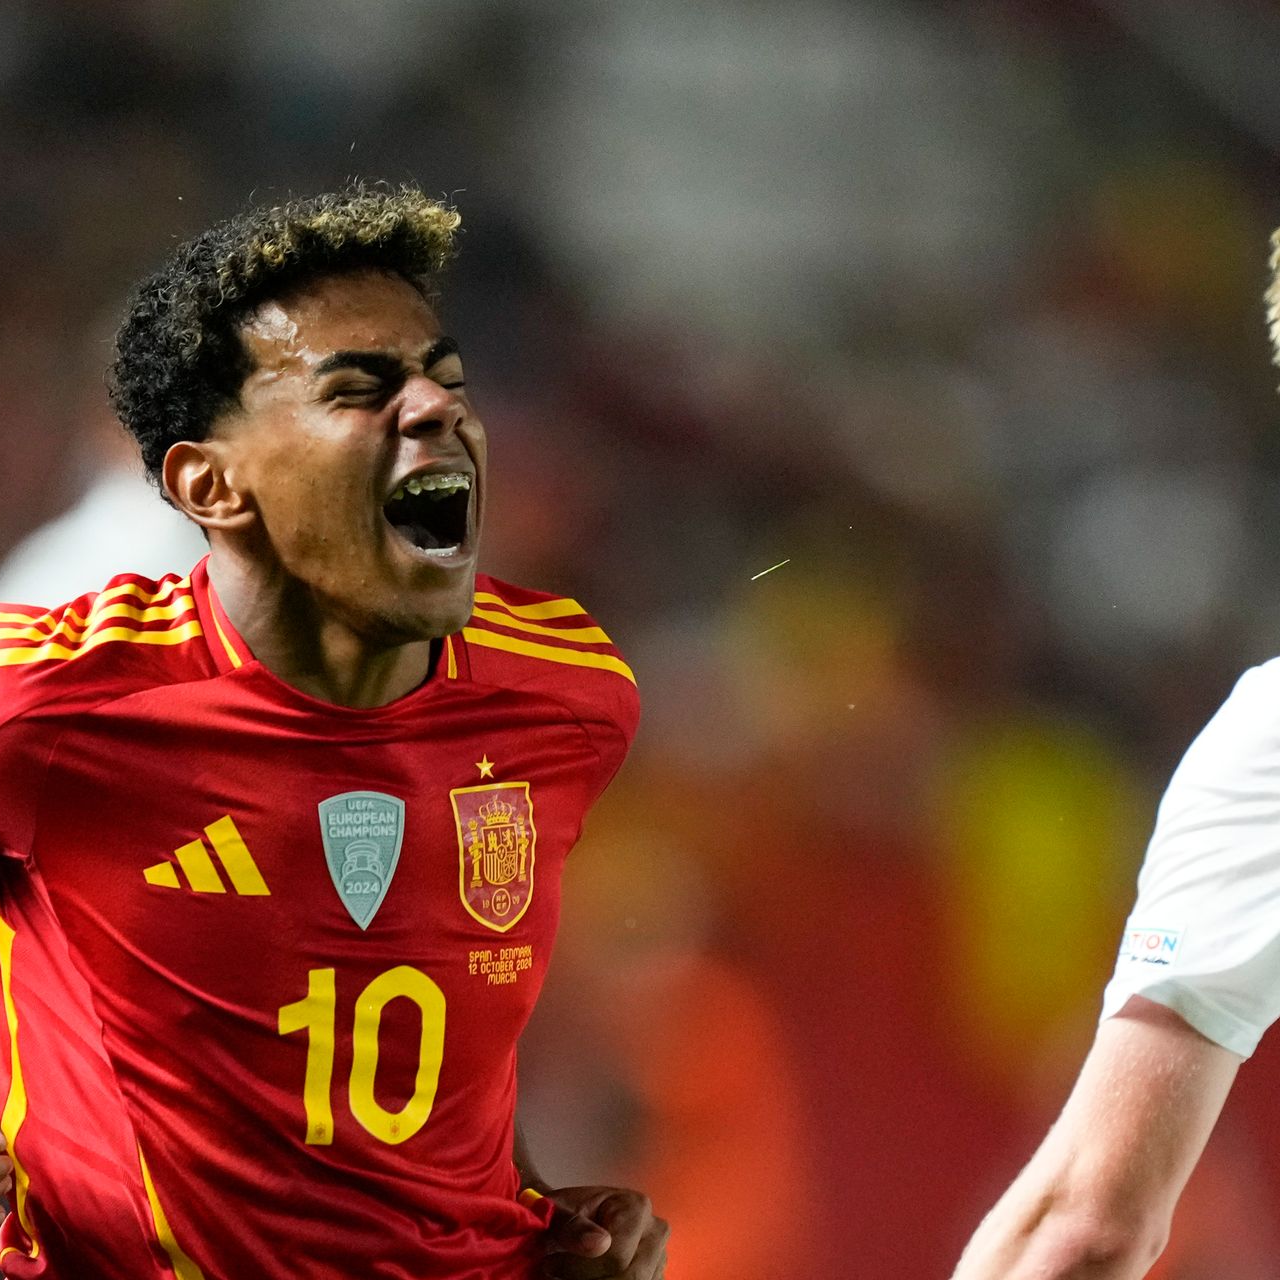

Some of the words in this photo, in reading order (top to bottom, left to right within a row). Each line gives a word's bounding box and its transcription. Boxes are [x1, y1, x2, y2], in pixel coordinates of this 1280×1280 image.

[328, 812, 395, 825] EUROPEAN
[328, 826, 396, 838] CHAMPIONS
[345, 882, 380, 894] 2024
[469, 950, 492, 962] SPAIN
[500, 945, 532, 960] DENMARK
[468, 963, 478, 975] 12
[480, 960, 514, 974] OCTOBER
[516, 957, 532, 971] 2024
[487, 971, 517, 985] MURCIA
[278, 965, 446, 1145] 10
